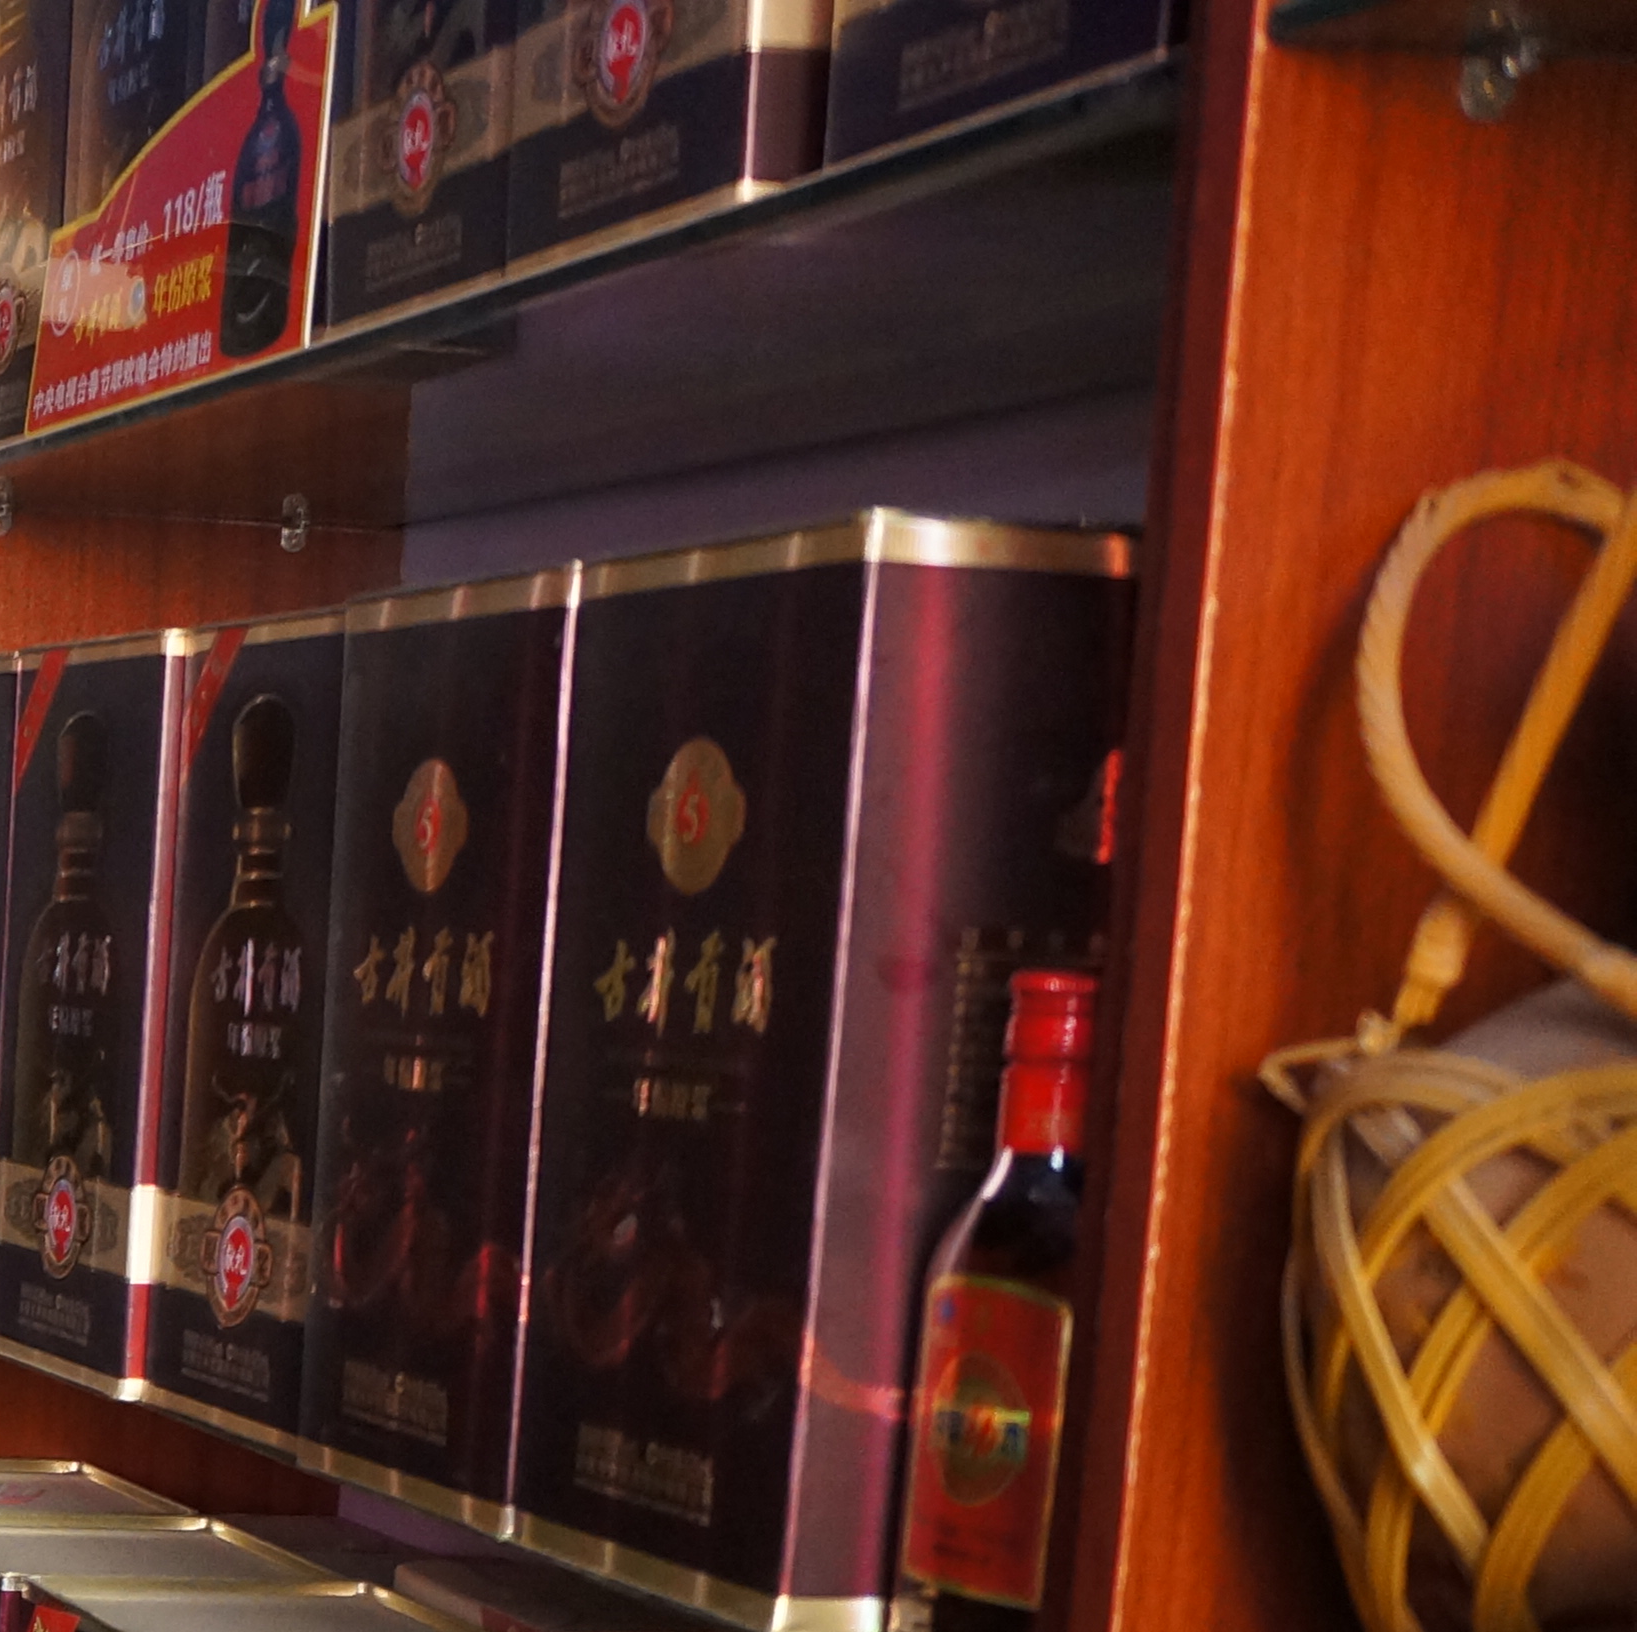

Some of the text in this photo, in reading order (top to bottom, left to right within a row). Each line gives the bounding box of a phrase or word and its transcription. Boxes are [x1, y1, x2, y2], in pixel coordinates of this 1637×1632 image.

[353, 924, 494, 1018] 古井贡酒
[593, 922, 779, 1038] 古井贡酒
